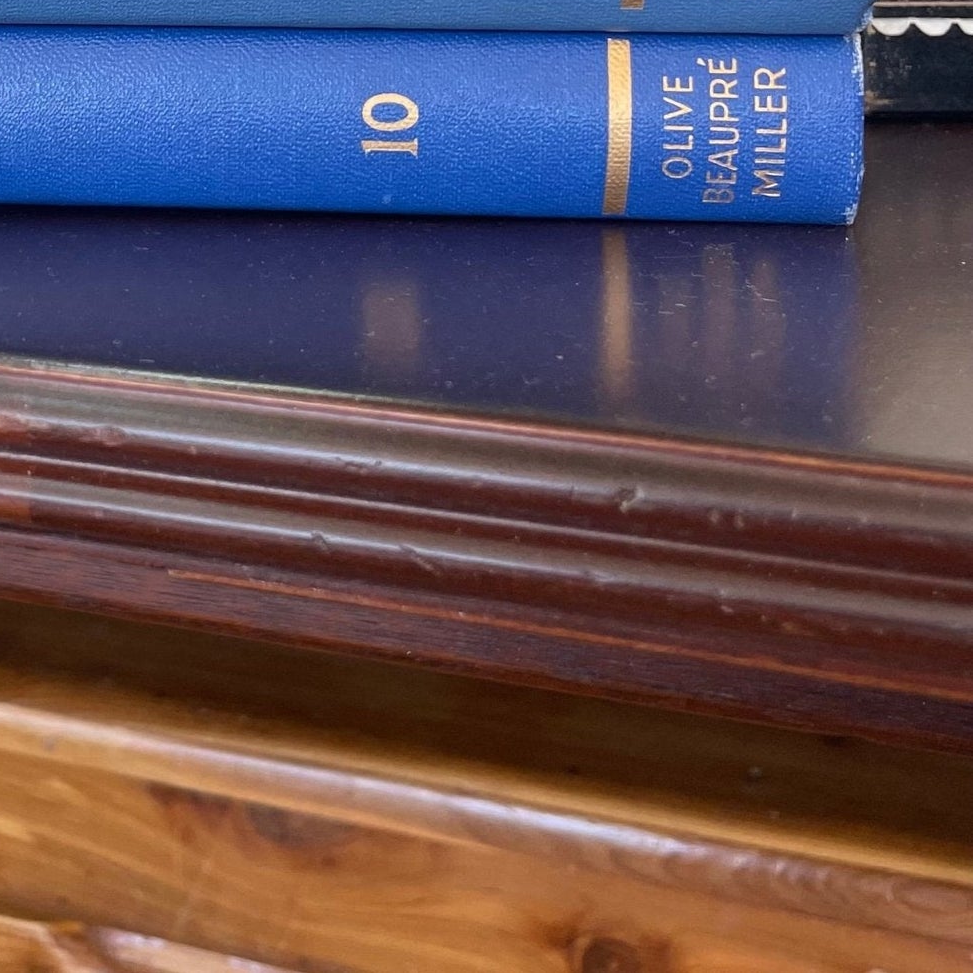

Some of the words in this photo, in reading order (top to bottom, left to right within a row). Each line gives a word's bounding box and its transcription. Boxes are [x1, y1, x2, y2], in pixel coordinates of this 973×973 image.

[361, 92, 419, 157] 10
[661, 75, 694, 179] OLIVE
[696, 57, 737, 204] BEAUPRÉ
[751, 66, 787, 199] MILLER
